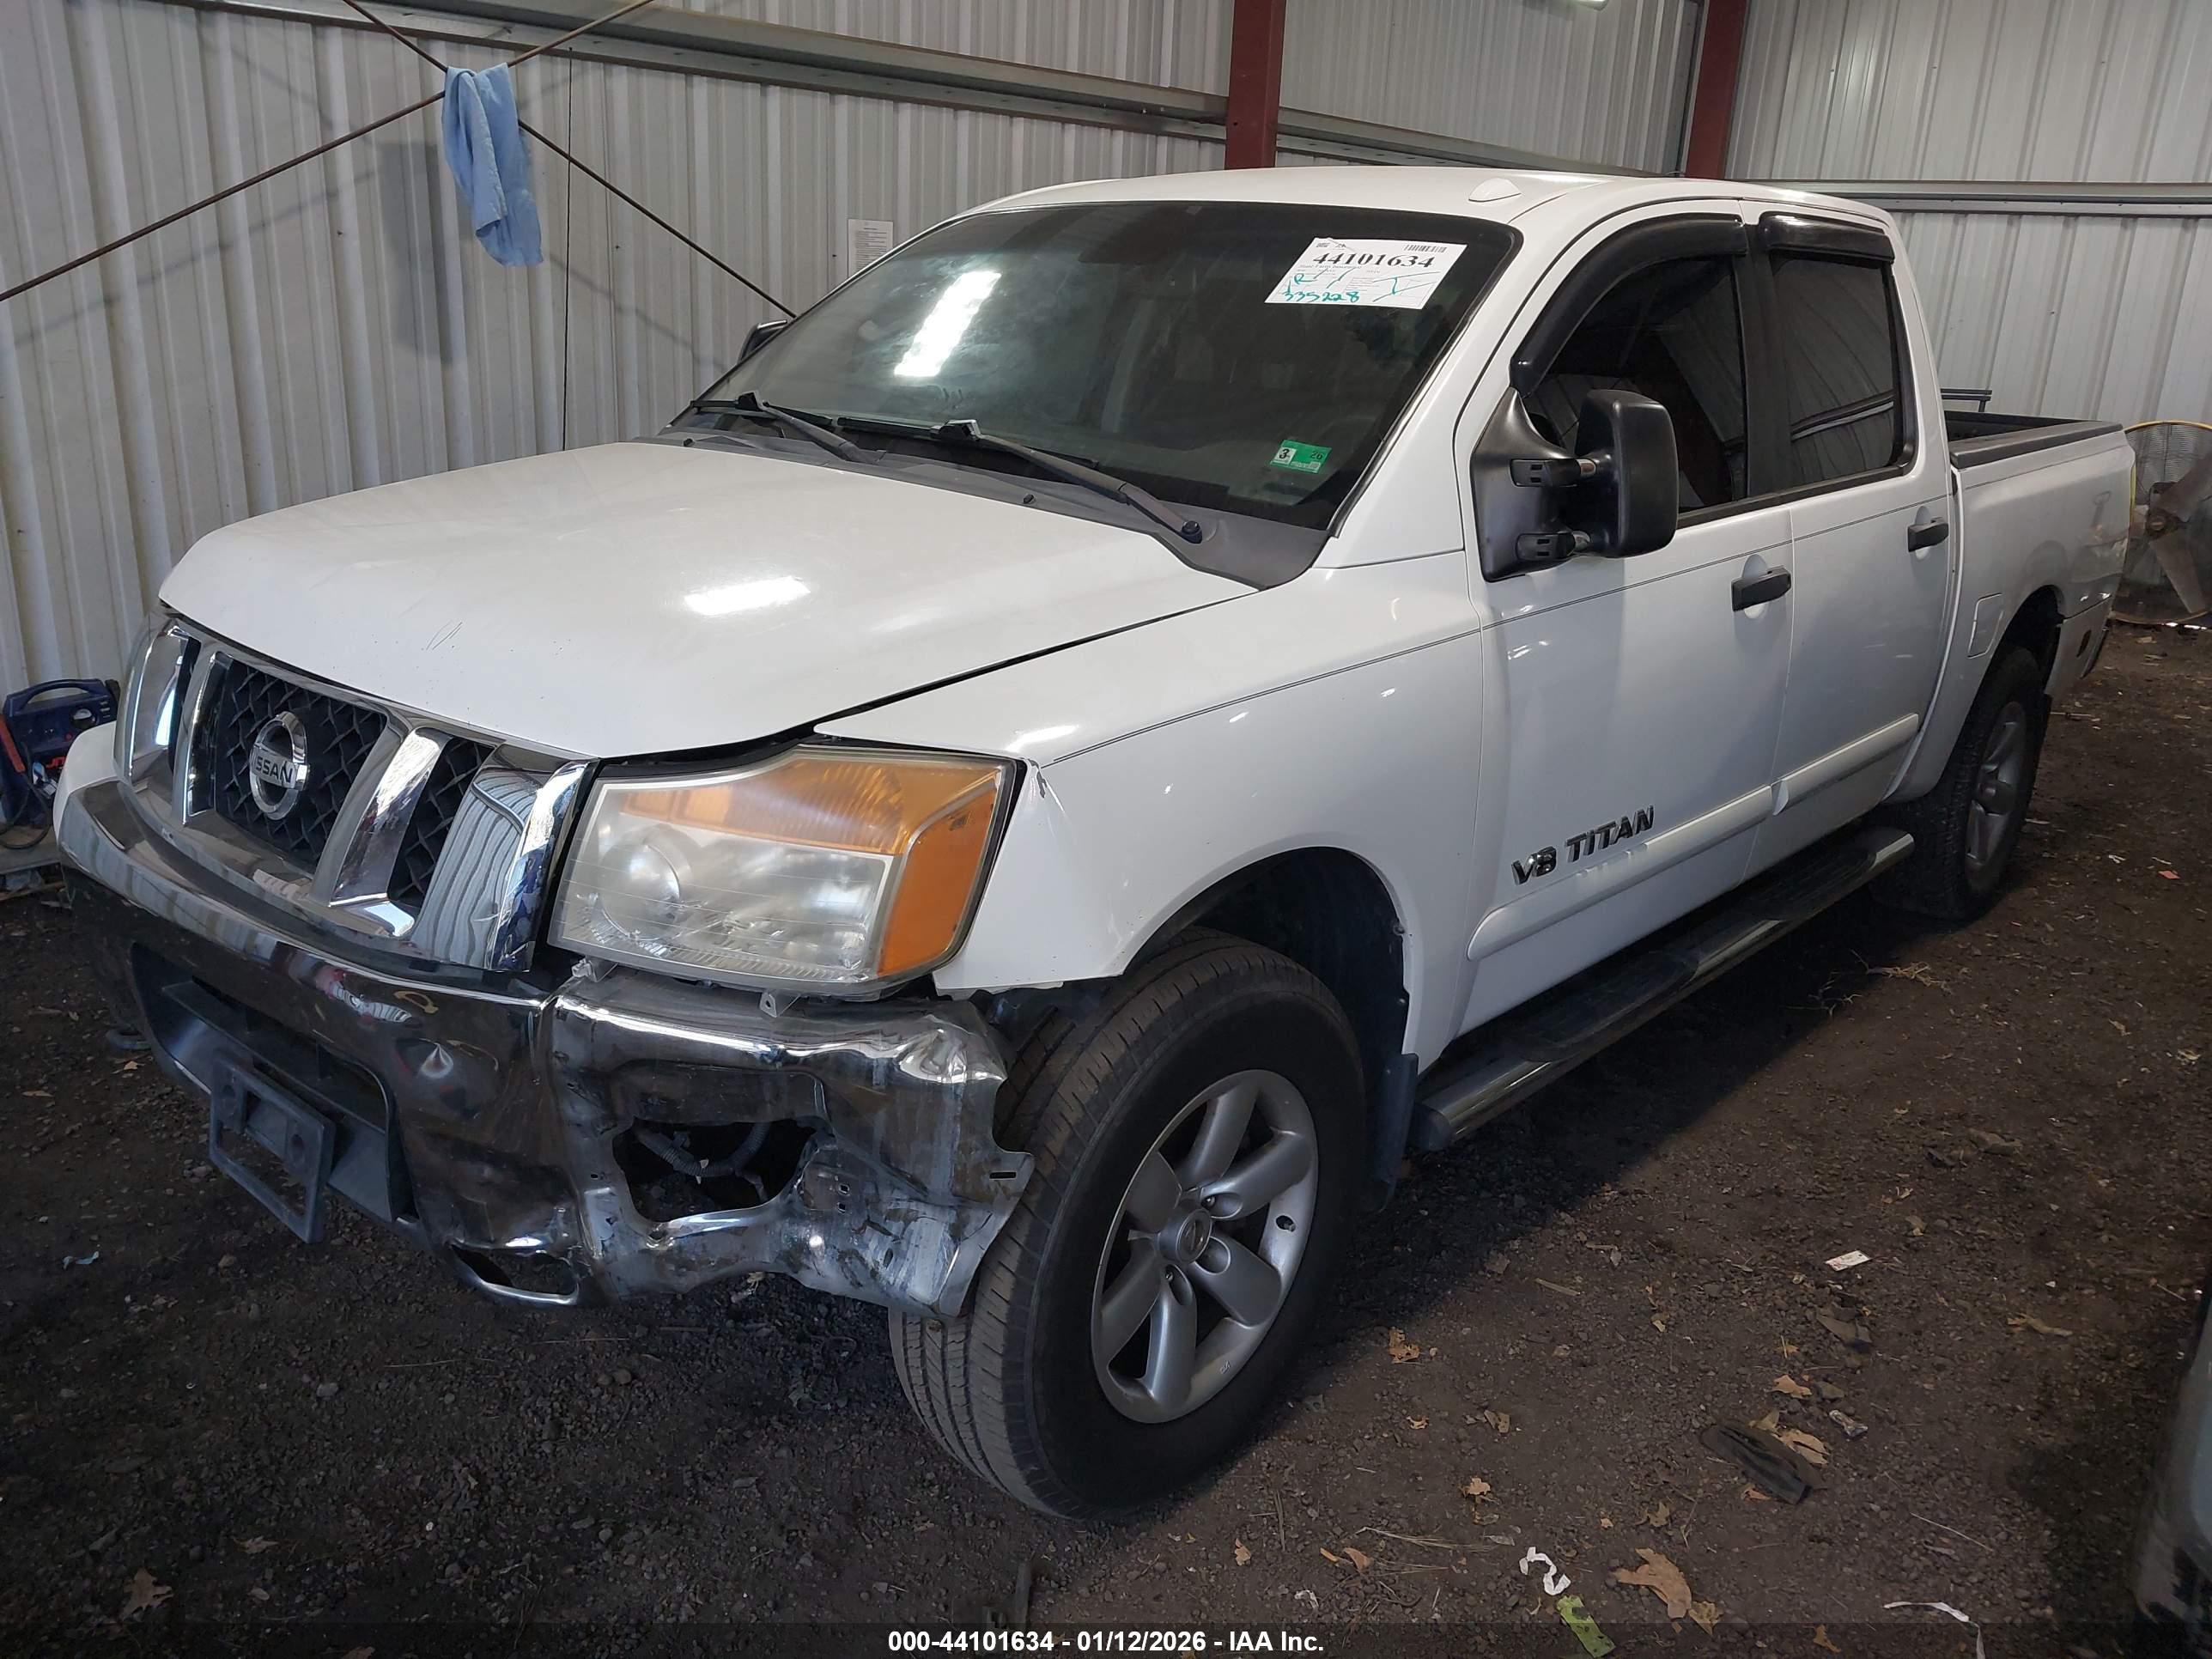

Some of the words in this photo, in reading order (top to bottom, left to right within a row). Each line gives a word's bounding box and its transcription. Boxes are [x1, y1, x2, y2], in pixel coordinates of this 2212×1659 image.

[1312, 252, 1435, 268] 44101634
[1279, 448, 1290, 459] 3
[1511, 846, 1557, 885] V8
[1565, 805, 1654, 863] TITAN
